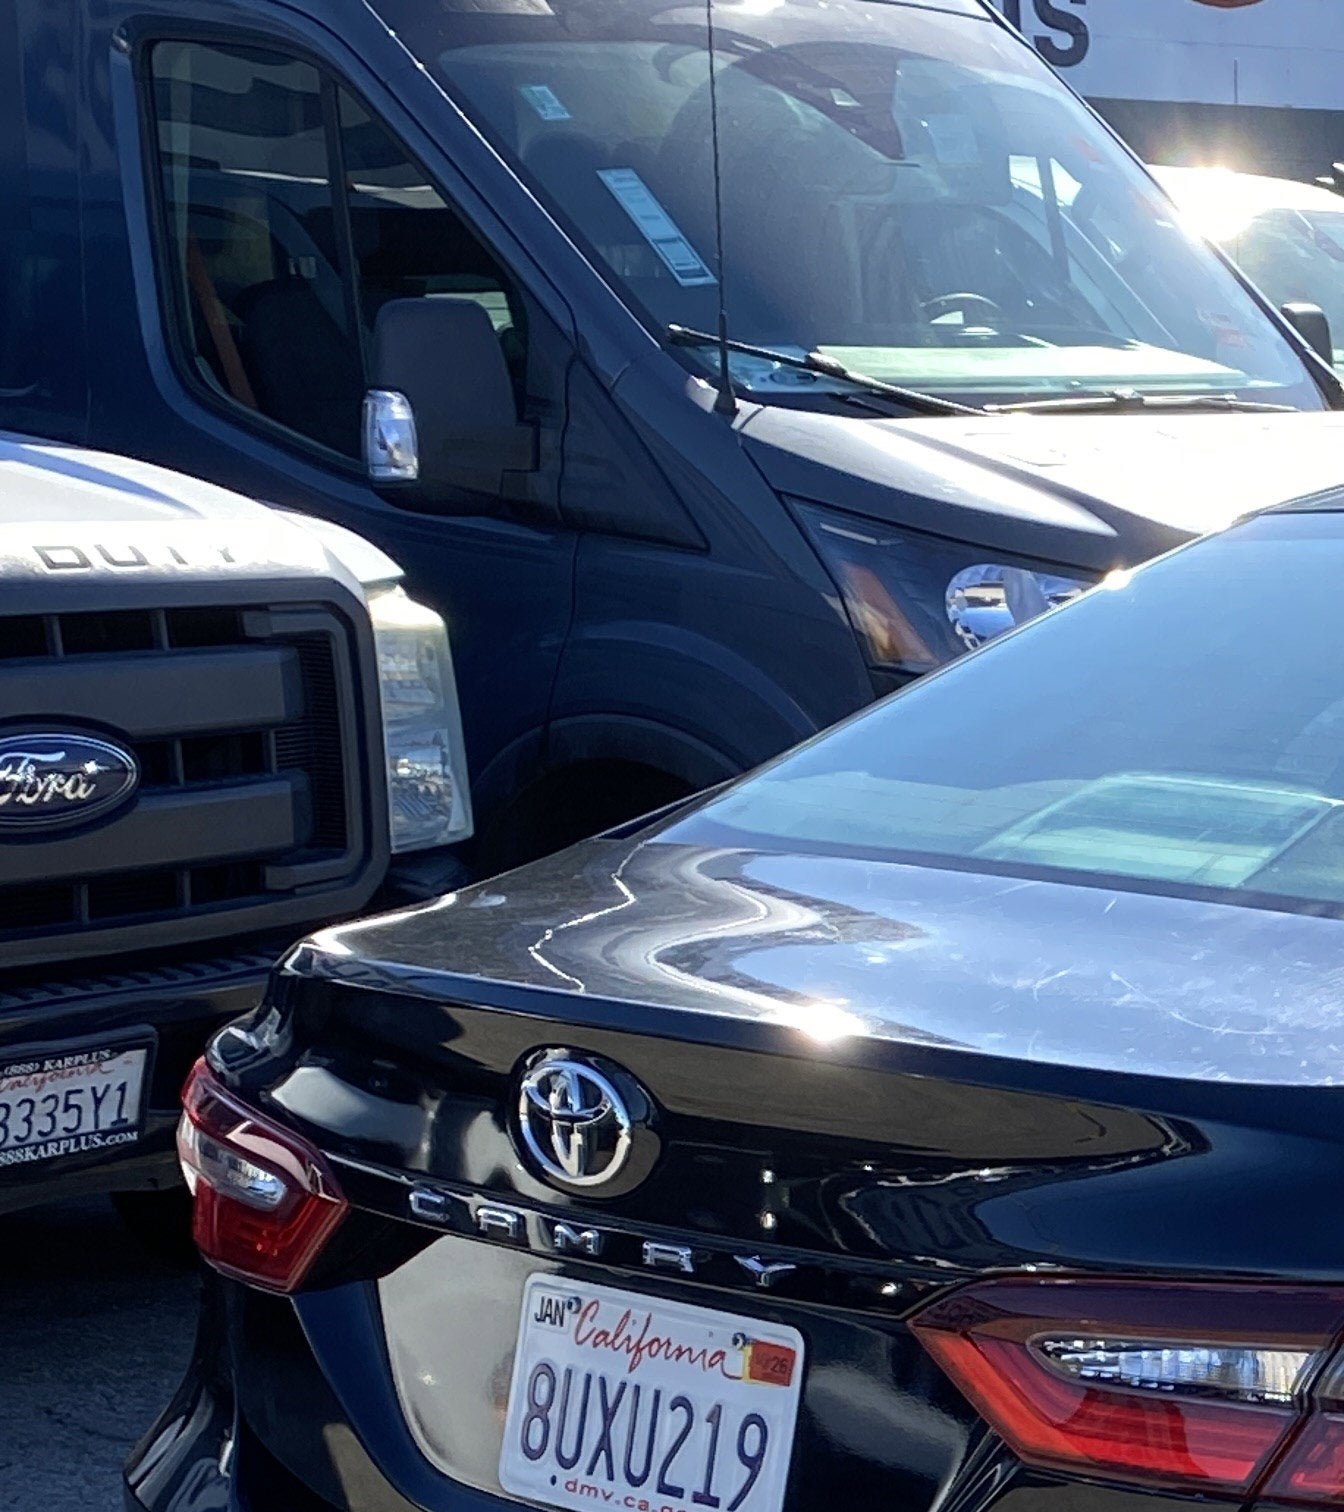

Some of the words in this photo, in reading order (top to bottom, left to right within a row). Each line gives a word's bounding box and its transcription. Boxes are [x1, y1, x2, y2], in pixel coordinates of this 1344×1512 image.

[409, 1188, 797, 1287] CAMRY
[534, 1296, 565, 1327] JAN
[574, 1299, 743, 1380] California
[520, 1362, 769, 1512] 8UXU219
